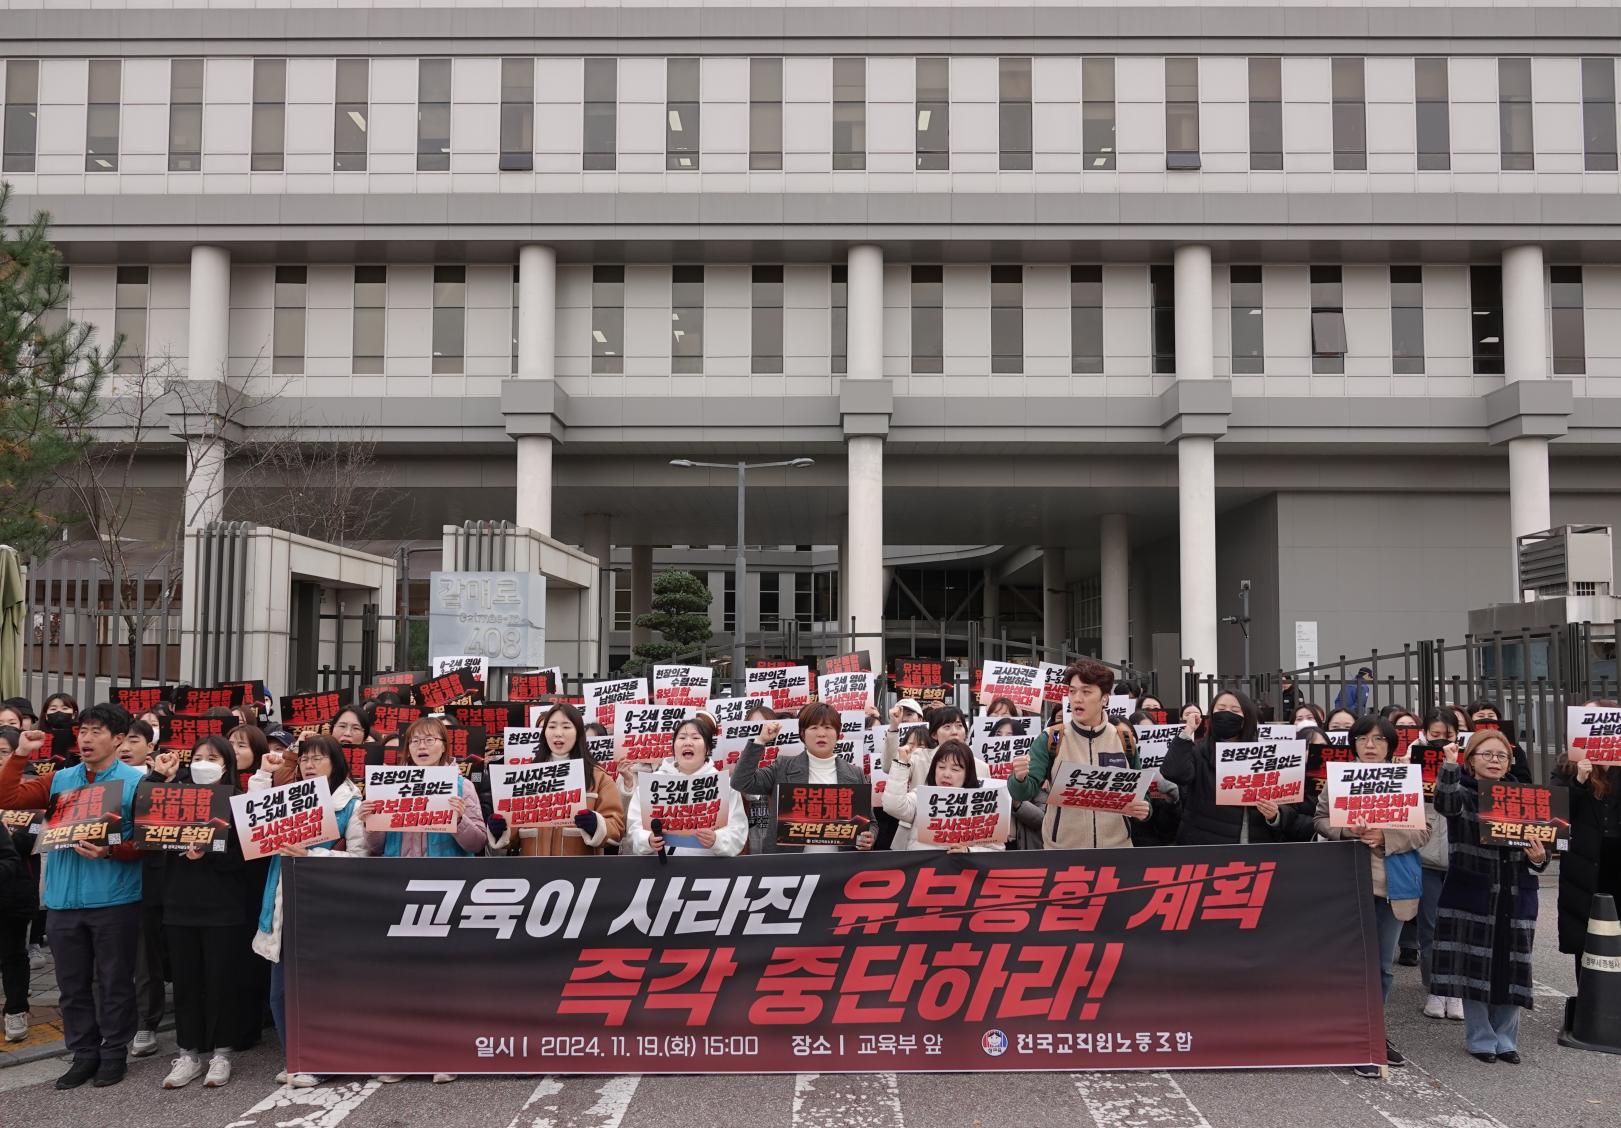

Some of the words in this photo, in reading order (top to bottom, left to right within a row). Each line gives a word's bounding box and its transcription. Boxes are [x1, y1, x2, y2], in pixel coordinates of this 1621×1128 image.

[439, 578, 521, 609] 갈매로
[463, 627, 520, 659] 408
[656, 668, 690, 679] 현장의견
[749, 669, 786, 682] 현장의견
[903, 663, 942, 675] 유보통합
[992, 666, 1037, 678] 교사자격증
[418, 674, 461, 694] 유보통합
[512, 675, 547, 687] 유보통합
[670, 677, 708, 688] 수렴없는
[768, 677, 806, 689] 수렴없는
[825, 676, 848, 688] 0-2세
[849, 674, 867, 684] 영아
[902, 673, 942, 686] 실행계획
[997, 675, 1032, 686] 남발하는
[118, 689, 161, 702] 유보통합
[187, 690, 232, 703] 유보통합
[593, 680, 638, 697] 교사자격증
[656, 687, 691, 698] 유보통합
[825, 684, 848, 696] 3-5세
[902, 687, 922, 699] 전면
[923, 688, 945, 699] 철회
[292, 693, 339, 710] 유보통합
[600, 691, 635, 705] 남발하는
[773, 695, 808, 711] 회하라!
[375, 706, 421, 722] 유보통합
[457, 708, 509, 722] 유보통합
[625, 710, 659, 722] 0-2세
[661, 708, 686, 721] 영아
[715, 701, 742, 715] 0-2세
[716, 712, 742, 724] 3-5세
[170, 719, 223, 737] 유보통합
[624, 721, 659, 734] 3-5세
[726, 723, 763, 739] 현장의
[622, 733, 673, 747] 교사전문
[982, 740, 1010, 754] 0-2세
[983, 751, 1012, 764] 3-5세
[1221, 745, 1277, 762] 현장의견
[1250, 753, 1302, 773] 수렴없는
[370, 768, 425, 786] 현장의견
[503, 762, 572, 786] 교사자격증
[1070, 769, 1112, 781] 0-2세
[1112, 772, 1141, 782] 영아
[1220, 772, 1281, 790] 유보통합
[1341, 766, 1408, 783] 교사자격증
[398, 781, 453, 798] 수렴없는
[511, 779, 565, 798] 남발하는
[651, 780, 688, 793] 0-2세
[691, 774, 719, 791] 영아
[1066, 779, 1108, 790] 3-5세
[1109, 782, 1137, 792] 유아
[1241, 781, 1301, 803] 철회하라!
[1351, 780, 1403, 796] 남발하는
[150, 787, 214, 805] 유보통합
[245, 790, 285, 814] 0-2세
[288, 780, 316, 800] 영아
[497, 789, 582, 813] 특별양성체제
[650, 793, 689, 805] 3-5세
[692, 787, 719, 803] 유아
[792, 787, 854, 805] 유보통합
[929, 793, 968, 806] 0-2세
[971, 790, 999, 803] 영아
[1334, 793, 1419, 811] 특별양성체제
[1491, 785, 1551, 804] 유보통합
[149, 803, 212, 822] 실행계획
[248, 807, 288, 828] 3-5세
[291, 794, 319, 814] 유아
[372, 796, 429, 814] 유보통합
[650, 799, 721, 818] 교사전문성
[792, 802, 853, 820] 실행계획
[928, 806, 968, 818] 3-5세
[970, 803, 998, 815] 유아
[1491, 801, 1551, 821] 실행계획
[3, 812, 35, 826] 철회
[250, 806, 324, 842] 교사전문성
[390, 810, 453, 829] 철회하라!
[511, 805, 571, 826] 반대한다!
[927, 813, 1000, 831] 교사전문성
[1347, 808, 1409, 824] 반대한다!
[42, 826, 72, 845] 전면
[72, 822, 109, 841] 철회
[146, 825, 180, 843] 전면
[181, 827, 216, 845] 철회
[789, 822, 823, 838] 전면
[824, 824, 858, 839] 철회
[932, 827, 994, 844] 강화하라!
[1491, 823, 1523, 840] 전면
[1524, 825, 1558, 843] 철회
[387, 877, 601, 939] 교육이
[607, 874, 820, 937] 사라진
[830, 866, 1120, 935] 유보통합
[1126, 862, 1276, 931] 계획
[556, 947, 738, 1026] 즉각
[749, 942, 1124, 1026] 중단하라!
[475, 1036, 514, 1058] 일시
[541, 1036, 605, 1057] 2024.
[611, 1036, 631, 1057] 11.
[637, 1036, 696, 1058] 19.(화)
[702, 1036, 758, 1056] 15:00
[791, 1035, 833, 1057] 장소
[858, 1034, 918, 1056] 교육부
[923, 1034, 943, 1055] 앞
[1016, 1031, 1193, 1055] 전국교직원노동조합
